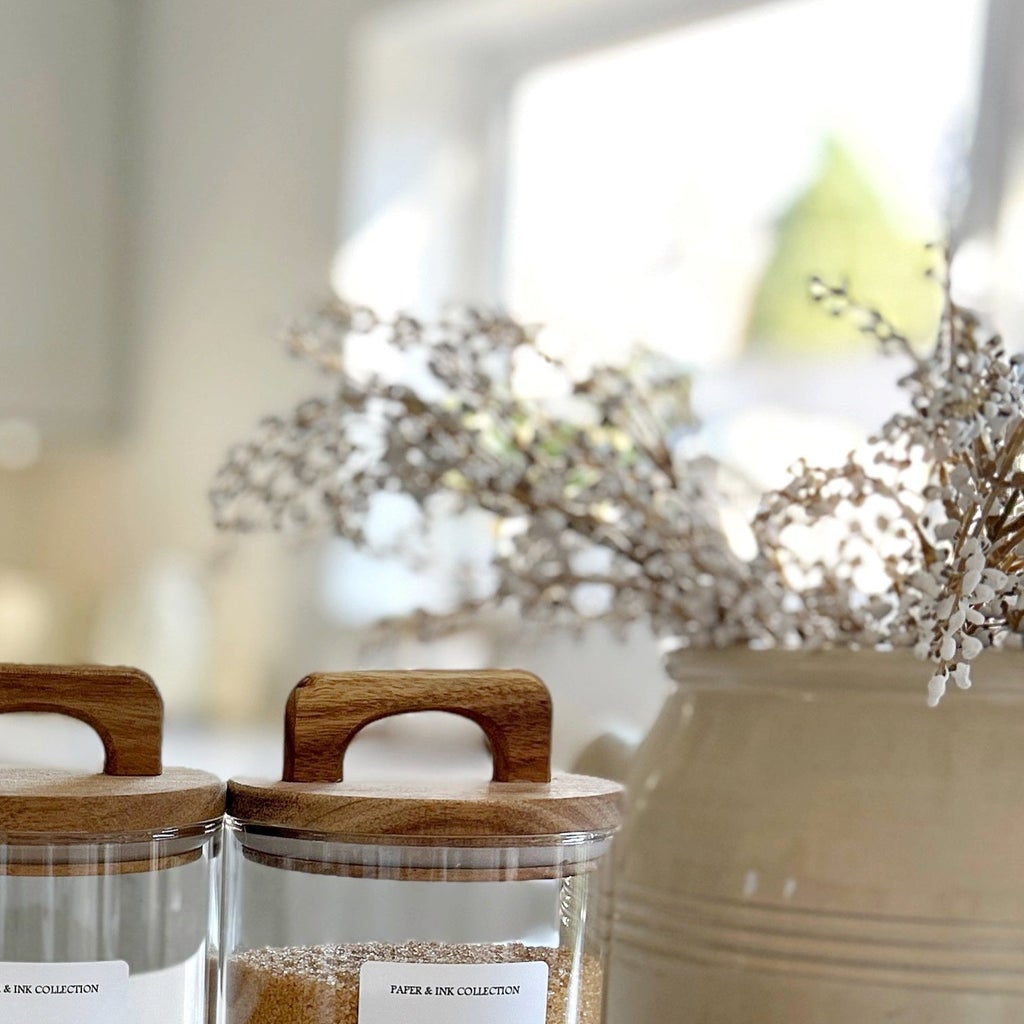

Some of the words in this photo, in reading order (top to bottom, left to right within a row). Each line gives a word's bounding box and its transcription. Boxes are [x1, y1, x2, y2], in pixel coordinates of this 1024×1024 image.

[3, 984, 12, 994] &
[12, 984, 33, 995] INK
[34, 983, 100, 995] COLLECTION
[389, 984, 423, 996] PAPER
[423, 986, 433, 996] &
[434, 986, 455, 997] INK
[456, 985, 521, 997] COLLECTION
